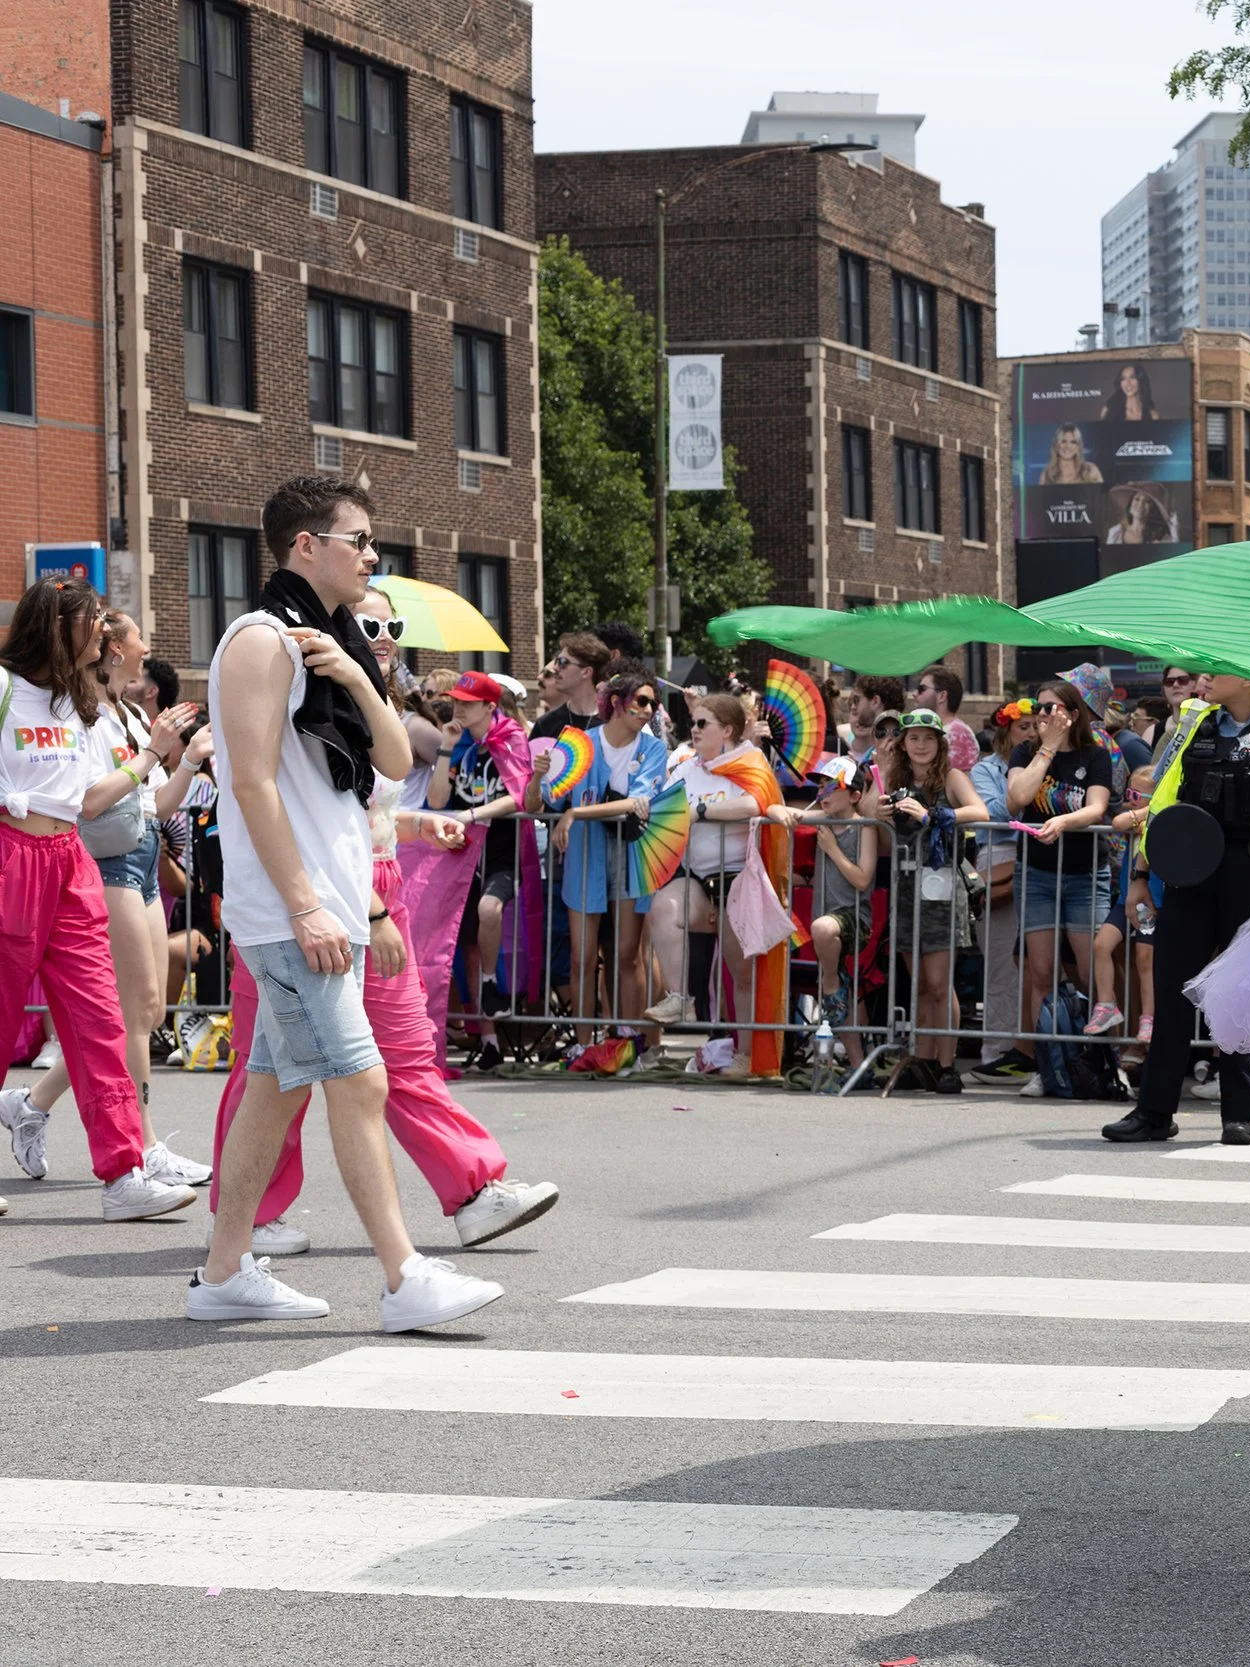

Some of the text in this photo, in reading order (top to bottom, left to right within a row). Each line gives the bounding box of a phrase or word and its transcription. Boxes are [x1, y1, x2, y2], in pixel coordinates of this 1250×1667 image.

[679, 369, 712, 385] third
[679, 429, 712, 445] third
[1046, 510, 1092, 524] VILLA
[14, 727, 86, 752] PRIDE
